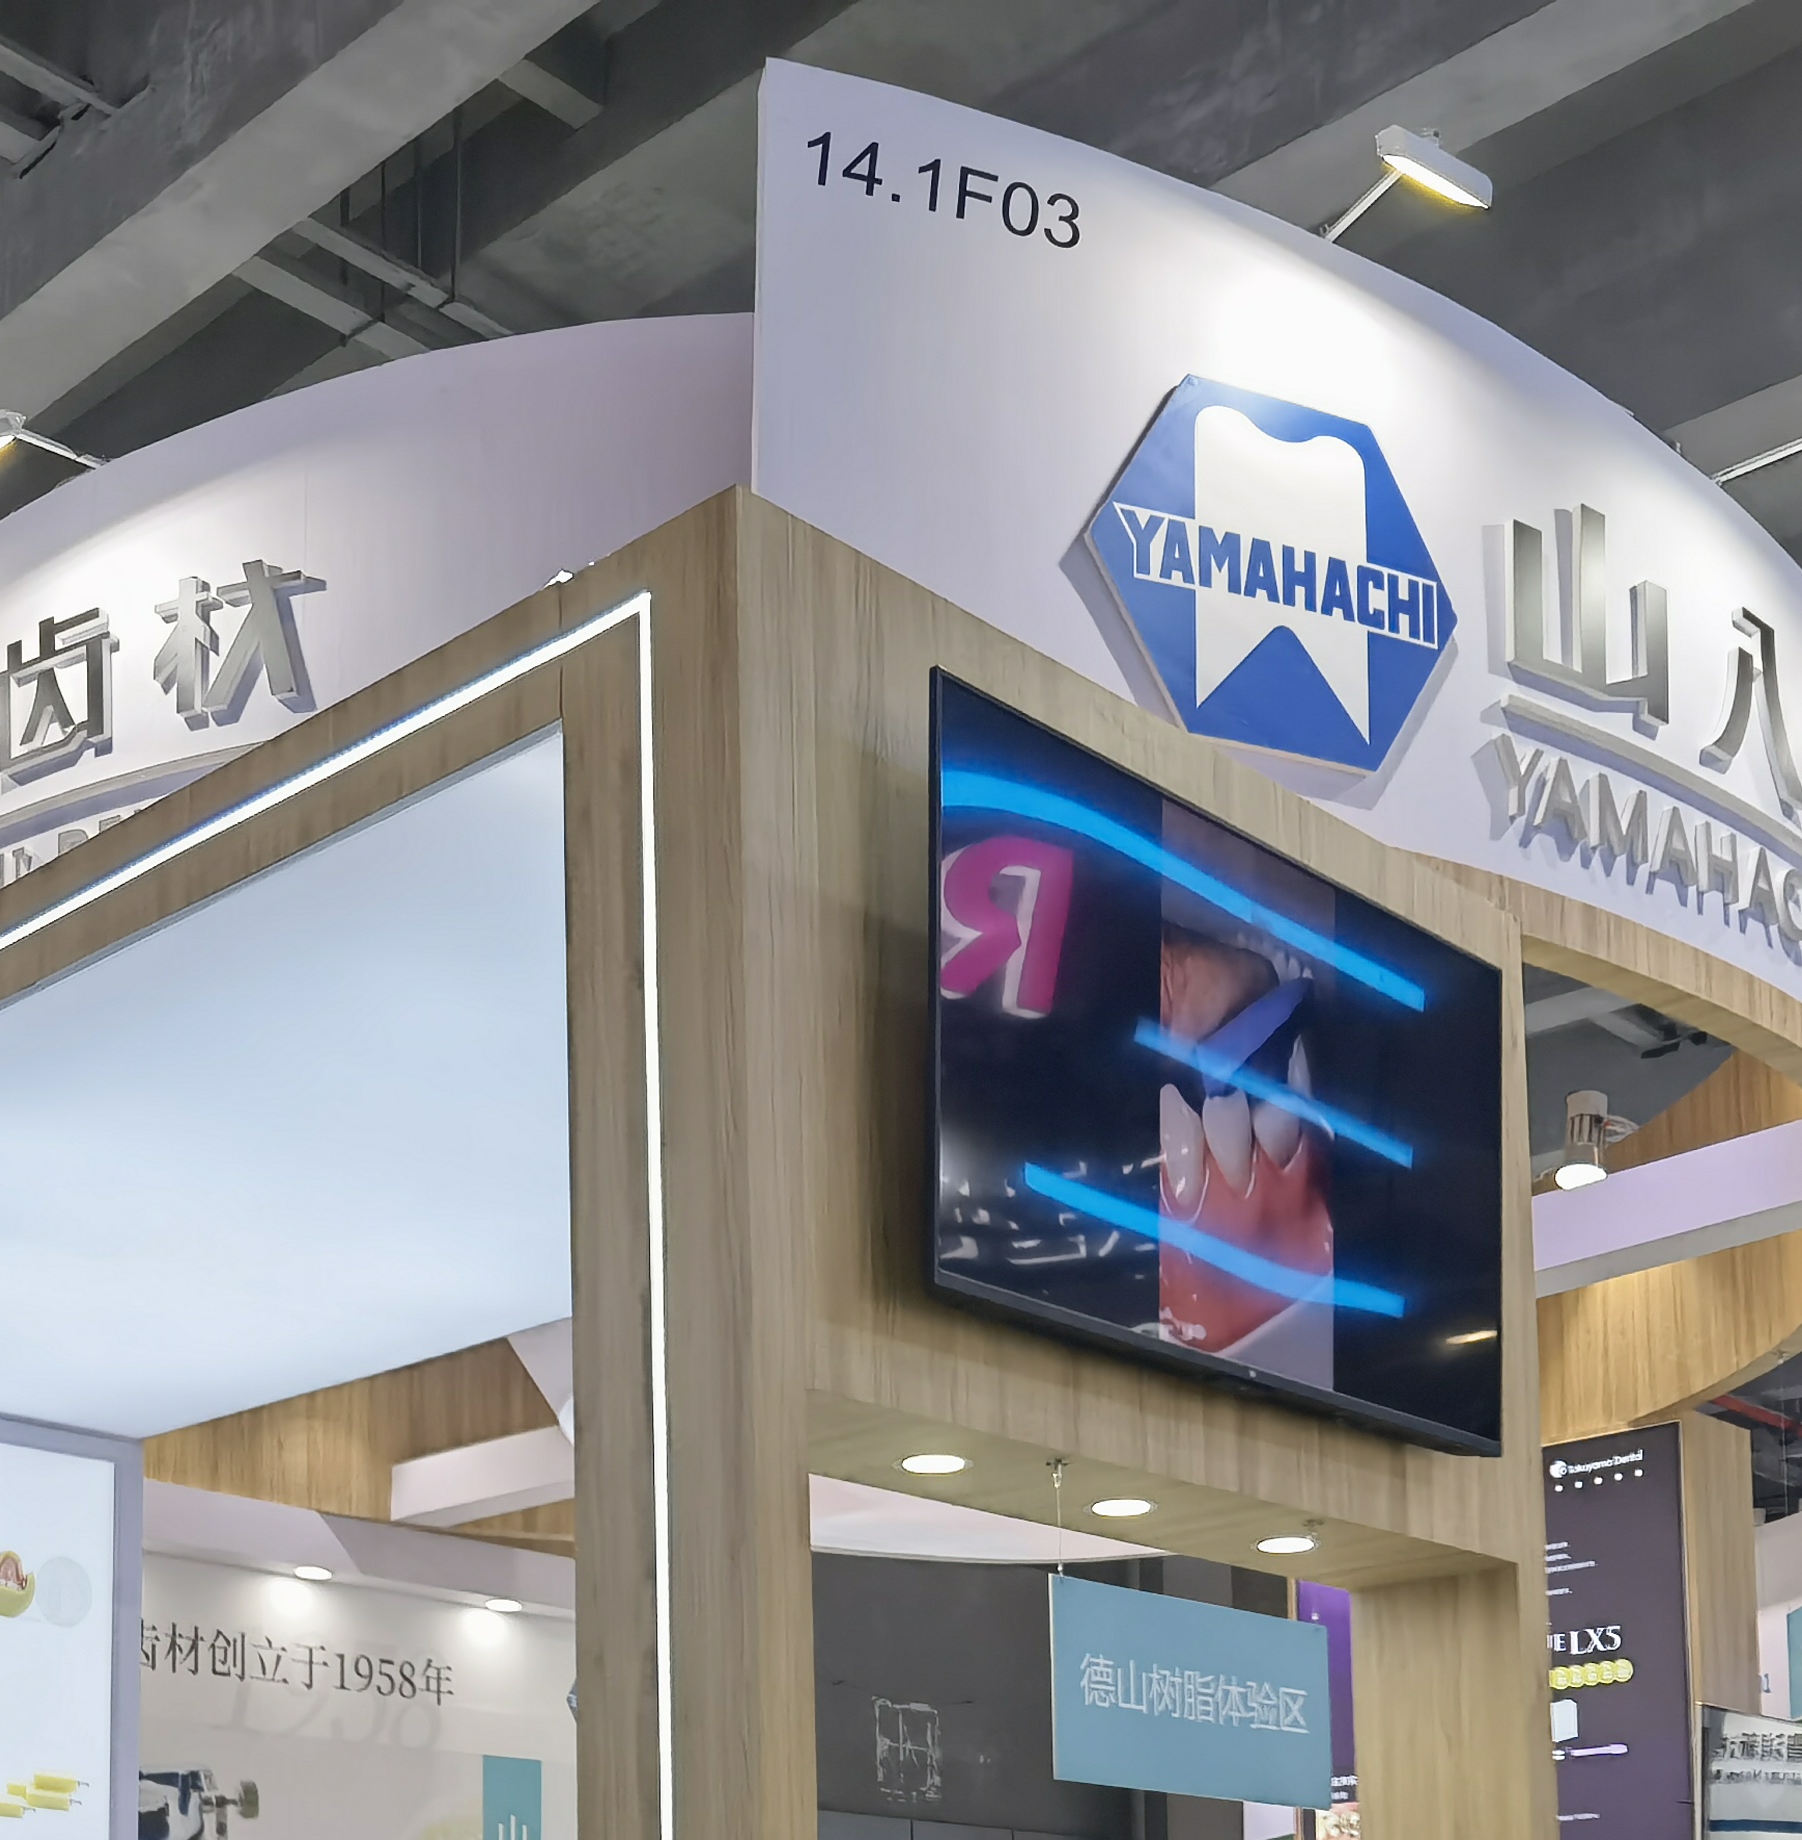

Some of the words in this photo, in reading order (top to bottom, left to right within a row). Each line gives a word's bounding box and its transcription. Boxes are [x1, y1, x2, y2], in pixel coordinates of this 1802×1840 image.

[806, 130, 1083, 250] 14.1F03
[1112, 502, 1440, 650] YAMAHACHI
[1569, 1624, 1622, 1655] LX5
[1079, 1652, 1310, 1735] 德山树脂体验区
